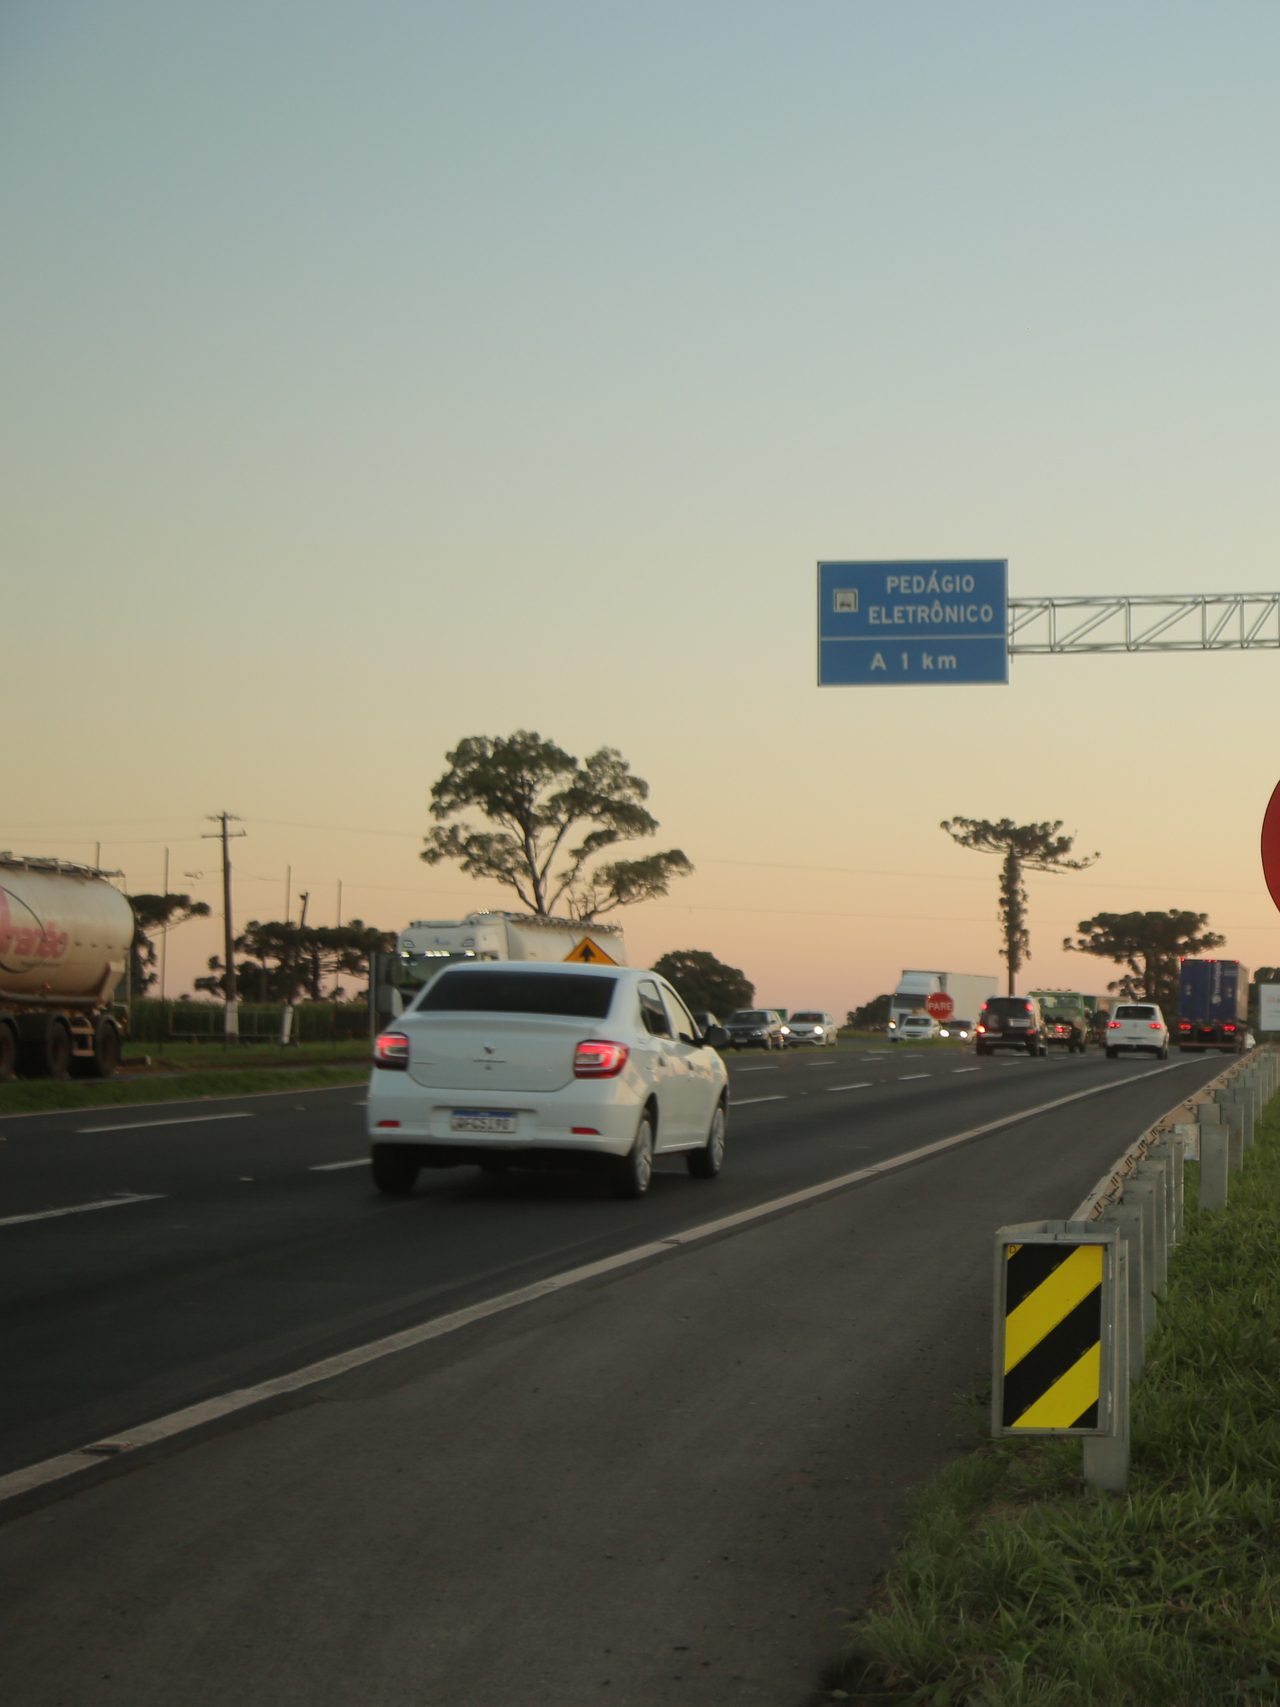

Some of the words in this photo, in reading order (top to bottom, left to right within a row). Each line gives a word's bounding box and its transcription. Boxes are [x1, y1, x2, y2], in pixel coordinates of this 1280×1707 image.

[887, 570, 975, 594] PEDÁGIO
[868, 600, 993, 624] ELETRÔNICO
[870, 653, 887, 670] A
[901, 653, 909, 670] 1
[922, 653, 957, 670] km
[928, 1002, 953, 1011] PARE
